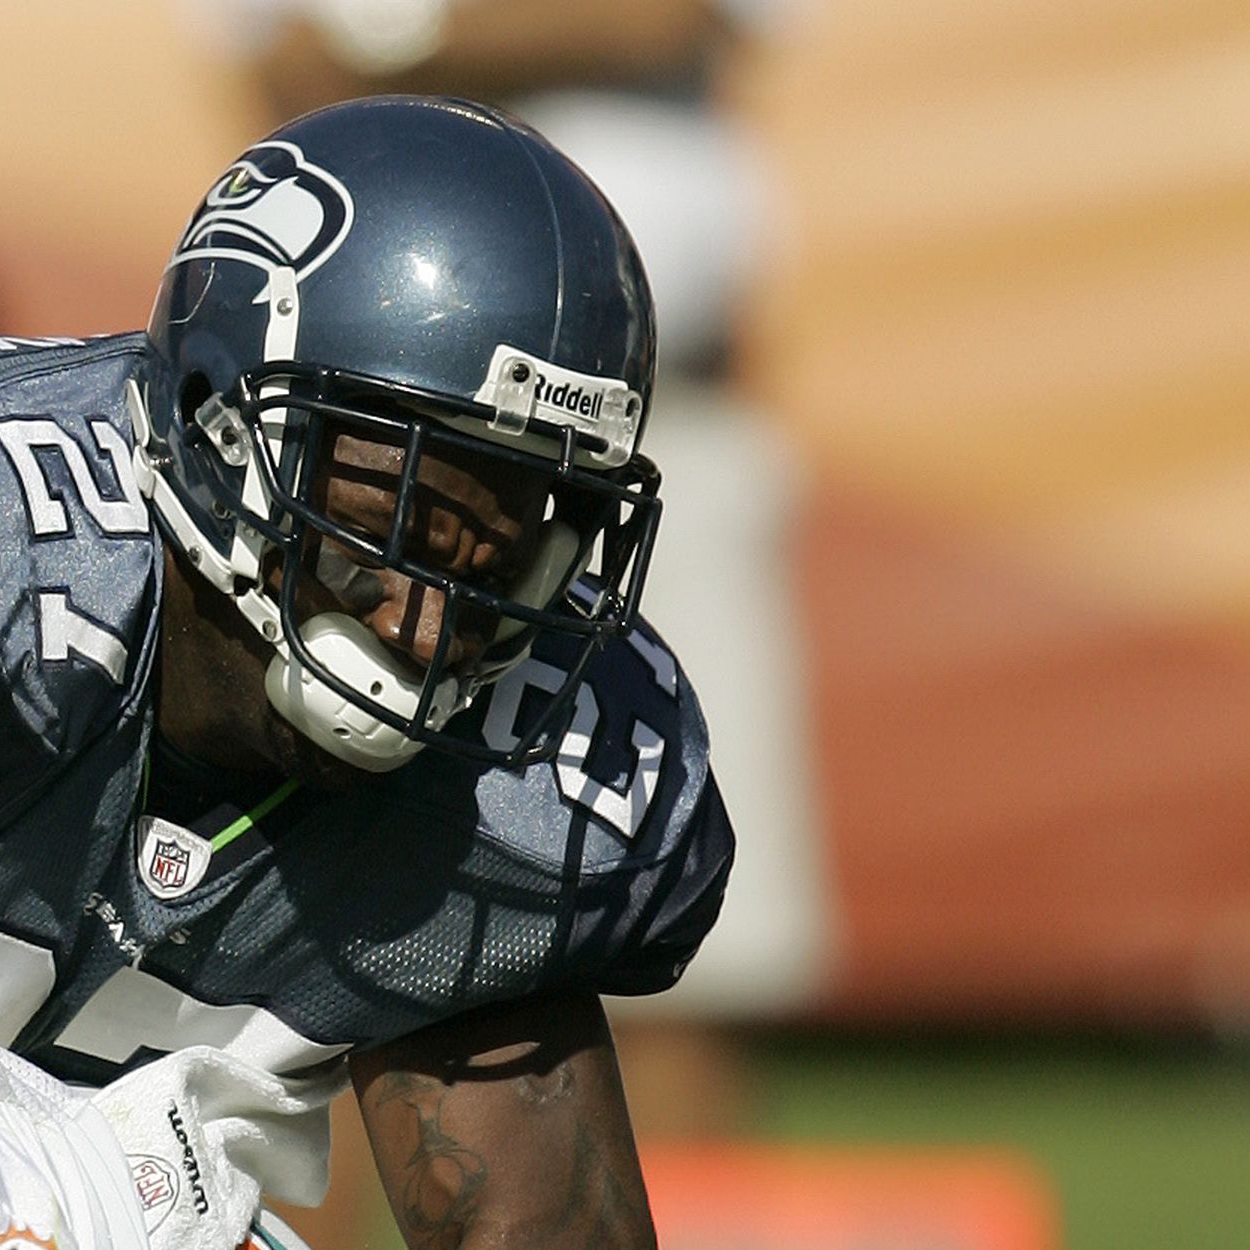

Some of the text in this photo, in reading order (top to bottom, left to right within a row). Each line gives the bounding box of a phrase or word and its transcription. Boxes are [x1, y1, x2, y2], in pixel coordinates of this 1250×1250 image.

[534, 373, 604, 420] Riddell
[153, 856, 186, 884] NFL
[136, 1164, 170, 1207] NFL
